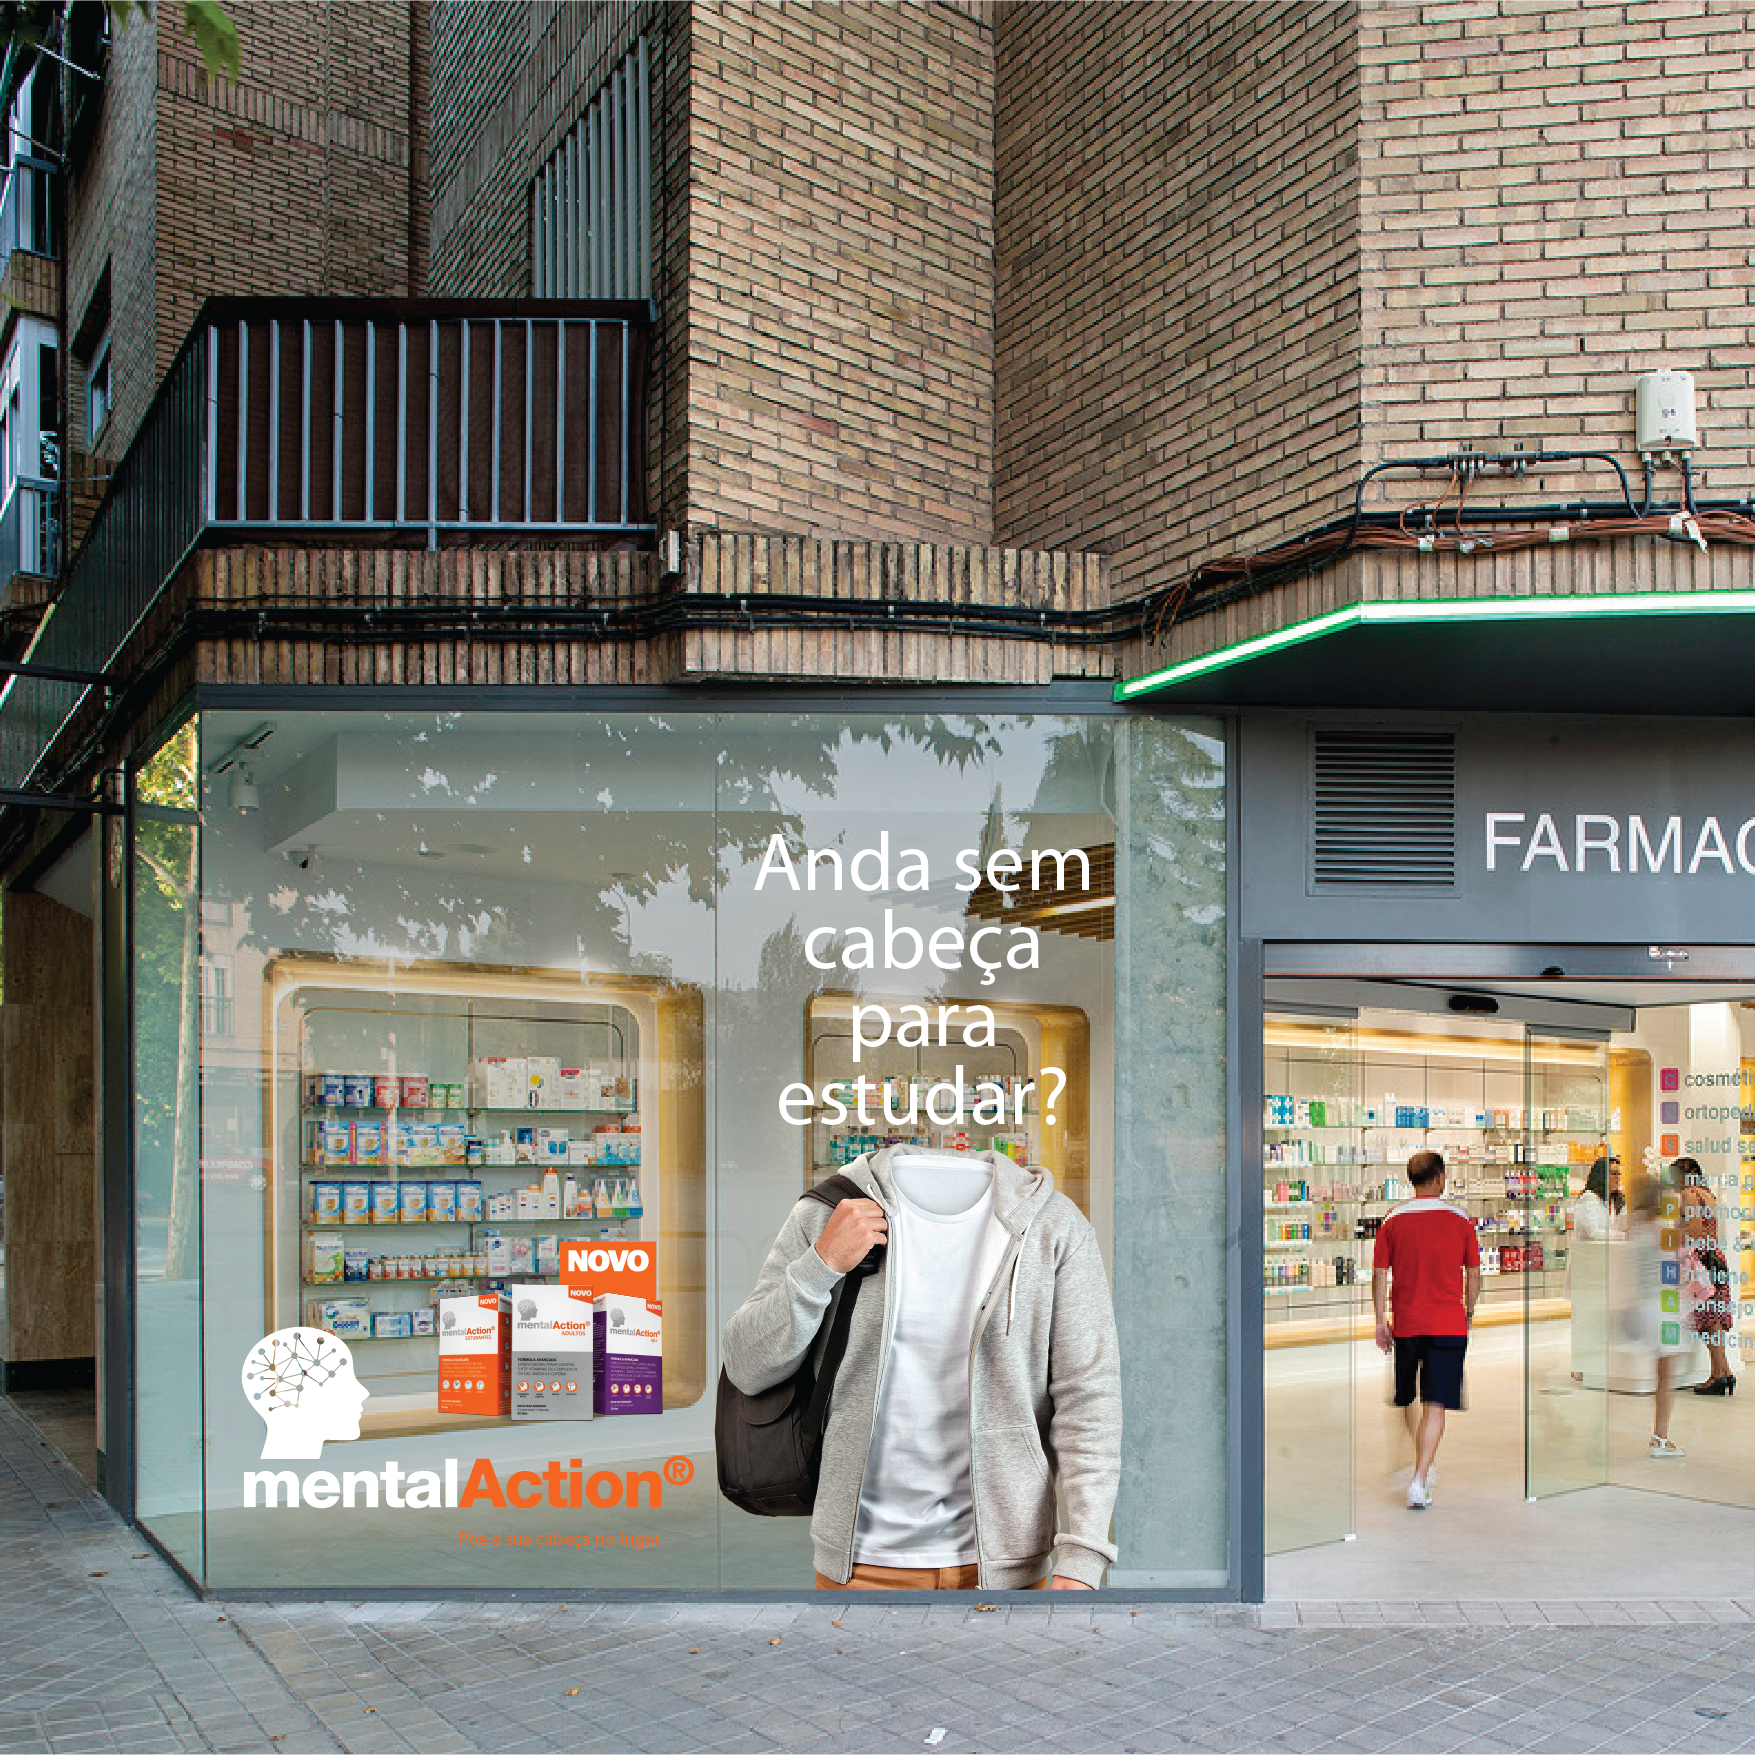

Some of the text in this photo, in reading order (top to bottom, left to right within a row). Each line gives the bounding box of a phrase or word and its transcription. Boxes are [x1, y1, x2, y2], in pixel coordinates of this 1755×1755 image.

[754, 831, 1090, 892] Anda sem
[804, 909, 1039, 986] cabeça
[852, 1004, 995, 1063] para
[778, 1064, 1067, 1126] estudar?
[1685, 1136, 1731, 1154] salud
[568, 1249, 649, 1272] NOVO
[480, 1297, 497, 1305] NOVO
[571, 1289, 592, 1297] NOVO
[647, 1303, 662, 1311] NOVO
[243, 1456, 695, 1509] mentalAction®
[459, 1530, 664, 1550] Põe a sua cabeça no lugar.
